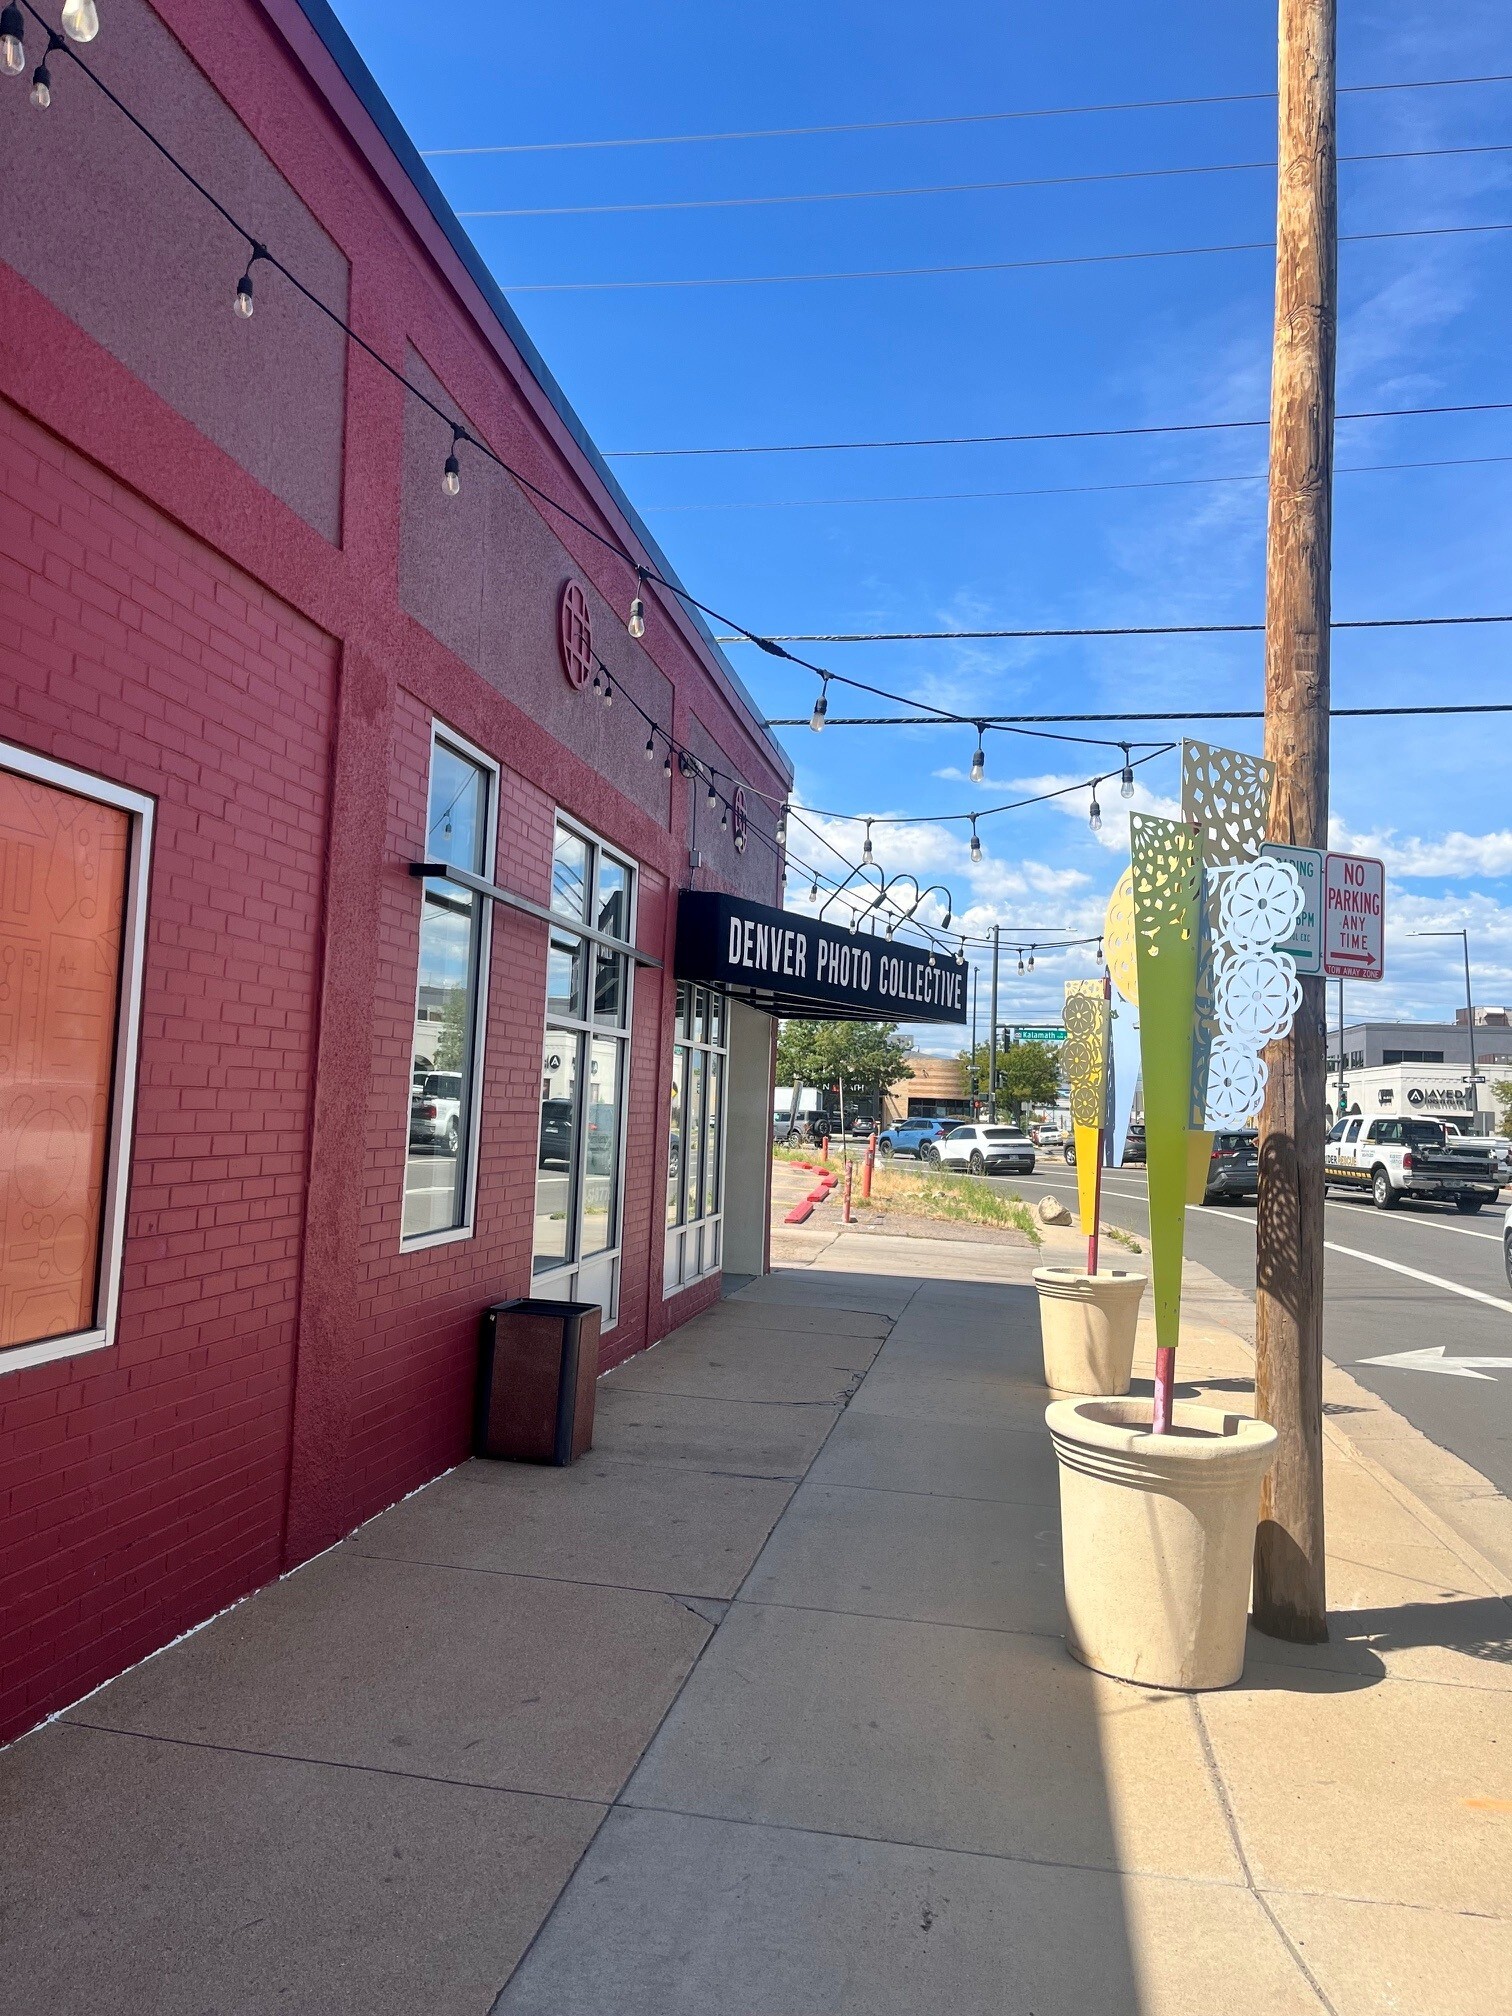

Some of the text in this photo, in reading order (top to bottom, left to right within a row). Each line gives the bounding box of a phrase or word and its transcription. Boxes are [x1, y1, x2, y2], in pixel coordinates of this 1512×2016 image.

[1344, 862, 1365, 887] NO
[1328, 887, 1380, 916] PARKING
[1342, 915, 1366, 932] ANY
[1340, 932, 1368, 950] TIME
[728, 916, 962, 1009] DENVER PHOTO COLLECTIVE
[1327, 965, 1380, 979] TOW AWAY ZONE
[1022, 1031, 1056, 1039] Kalamath
